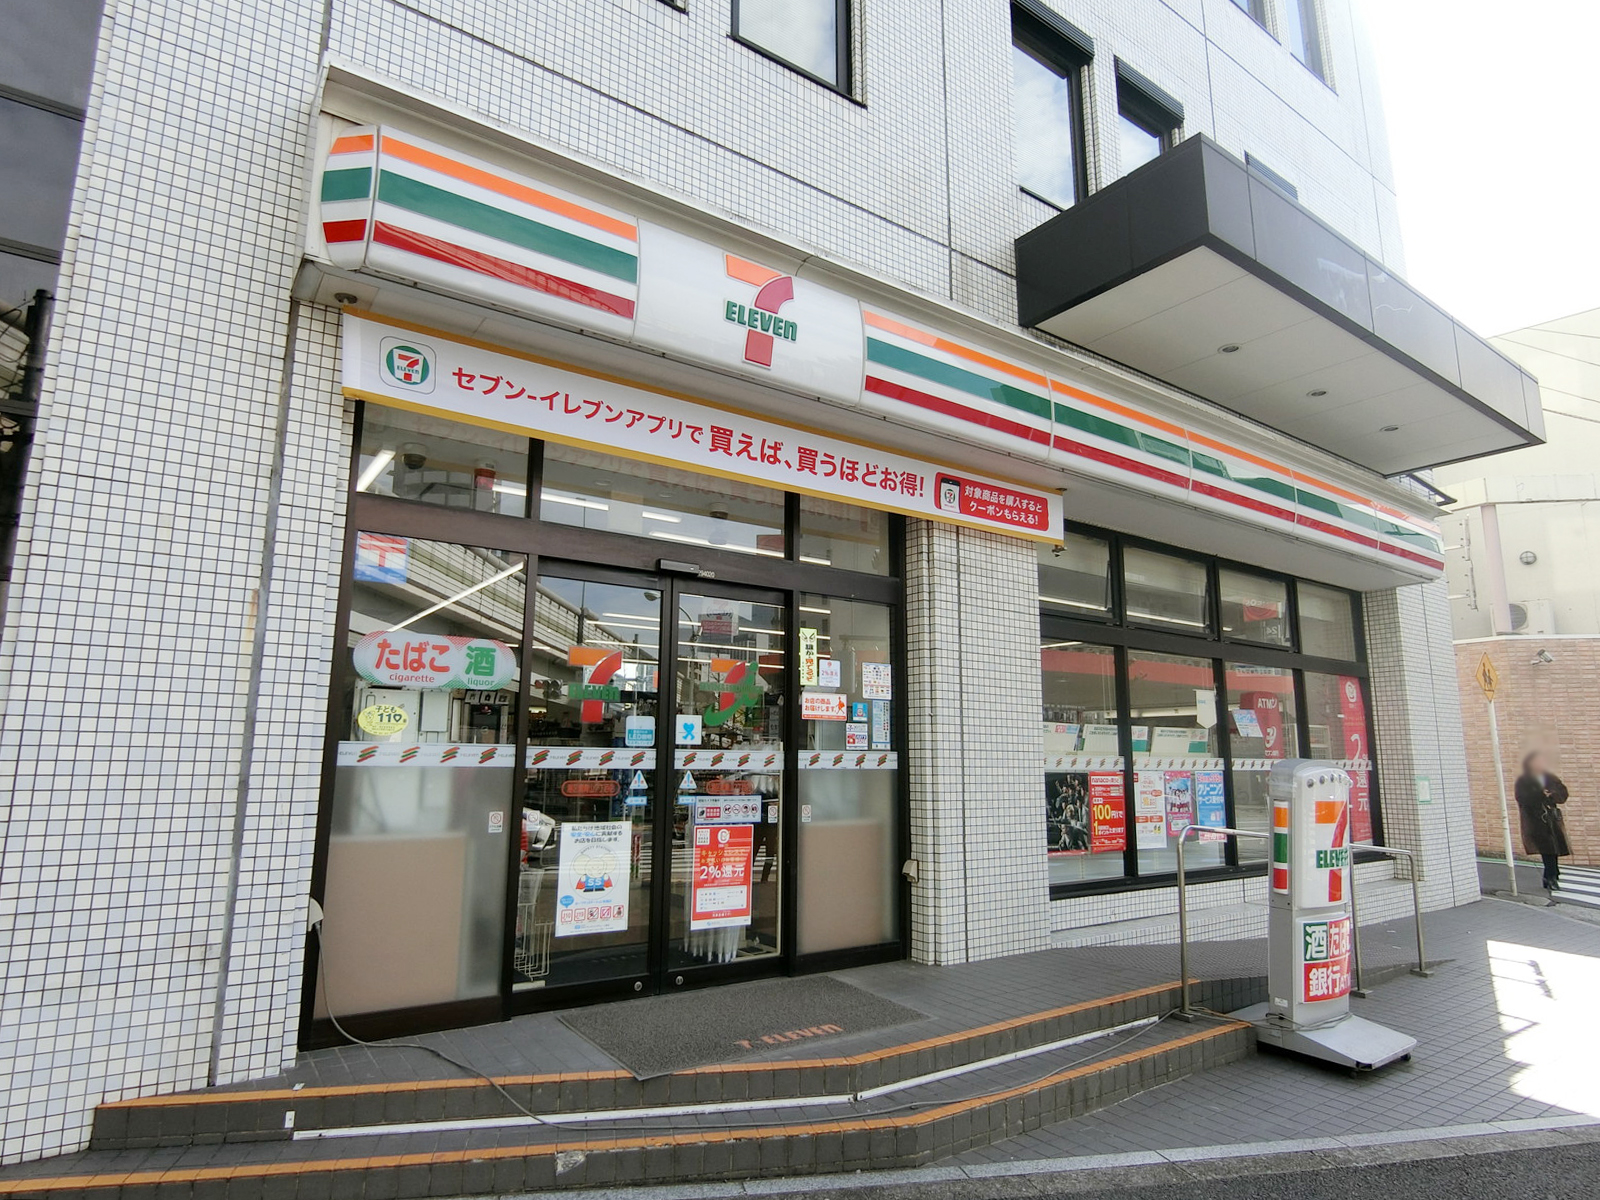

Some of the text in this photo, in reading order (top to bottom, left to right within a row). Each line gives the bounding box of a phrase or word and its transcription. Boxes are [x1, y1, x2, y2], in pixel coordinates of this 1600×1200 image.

[964, 485, 1043, 512] 対象商品を購入すると
[969, 501, 1039, 525] クーポンもらえる!
[375, 638, 496, 677] たばこ 酒
[389, 673, 495, 688] cigarette liquor
[376, 705, 397, 714] 子ども
[700, 864, 745, 880] 2%還元
[1305, 925, 1328, 960] 酒
